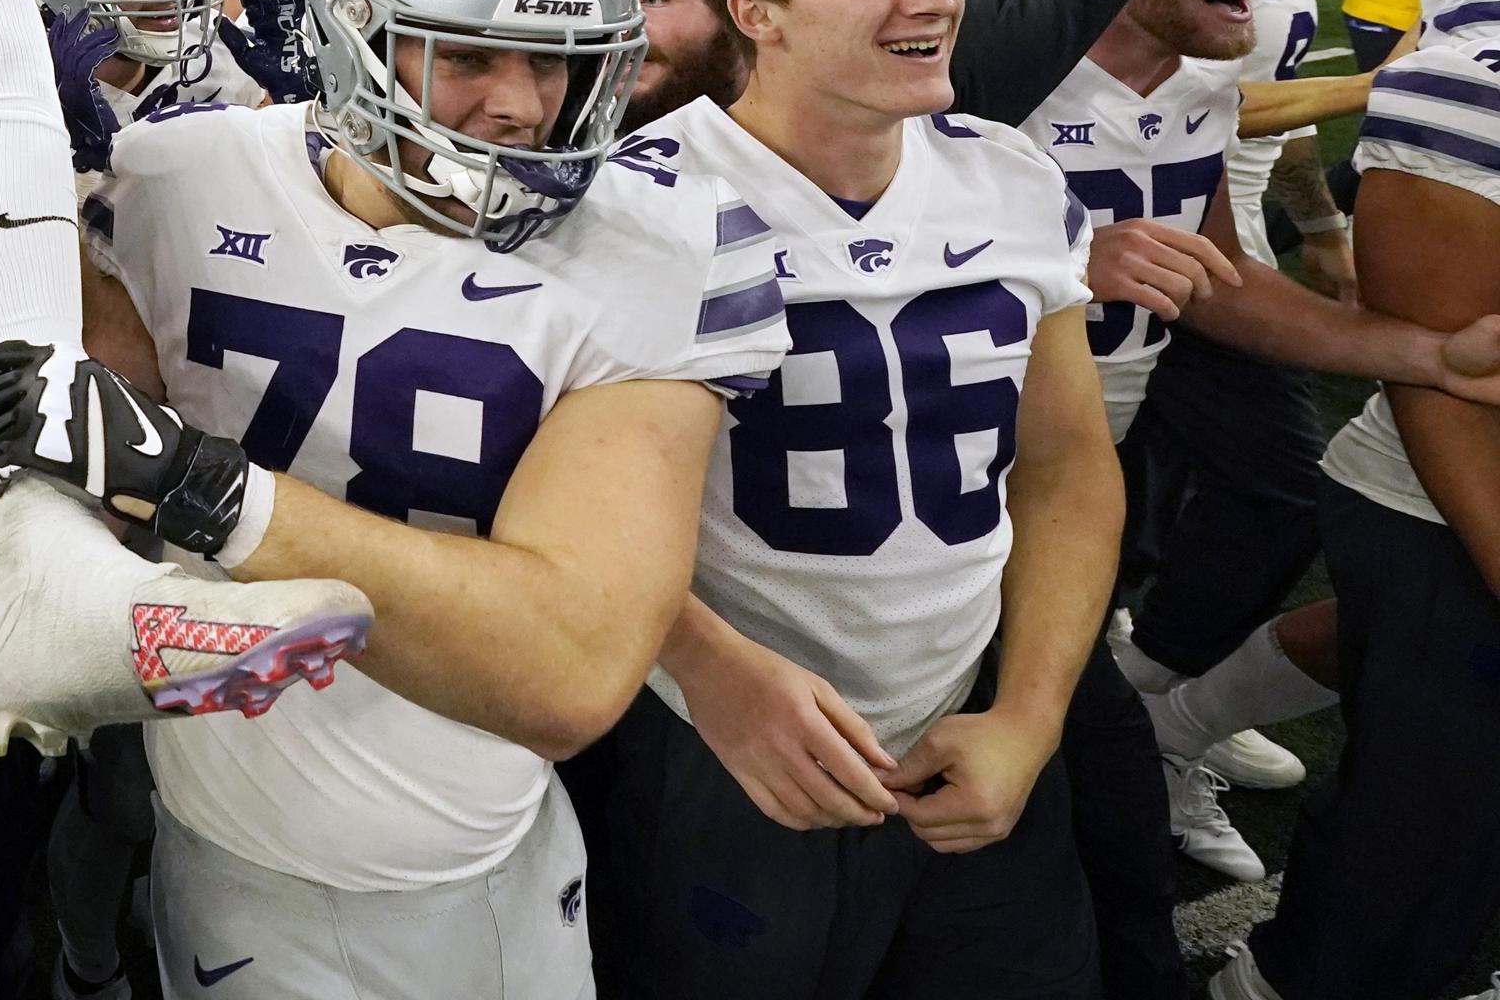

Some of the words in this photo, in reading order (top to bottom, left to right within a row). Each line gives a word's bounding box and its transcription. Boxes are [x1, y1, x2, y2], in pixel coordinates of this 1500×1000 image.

[1050, 121, 1097, 147] XII
[208, 224, 272, 265] XII
[186, 286, 545, 538] 78
[729, 279, 1028, 557] 86
